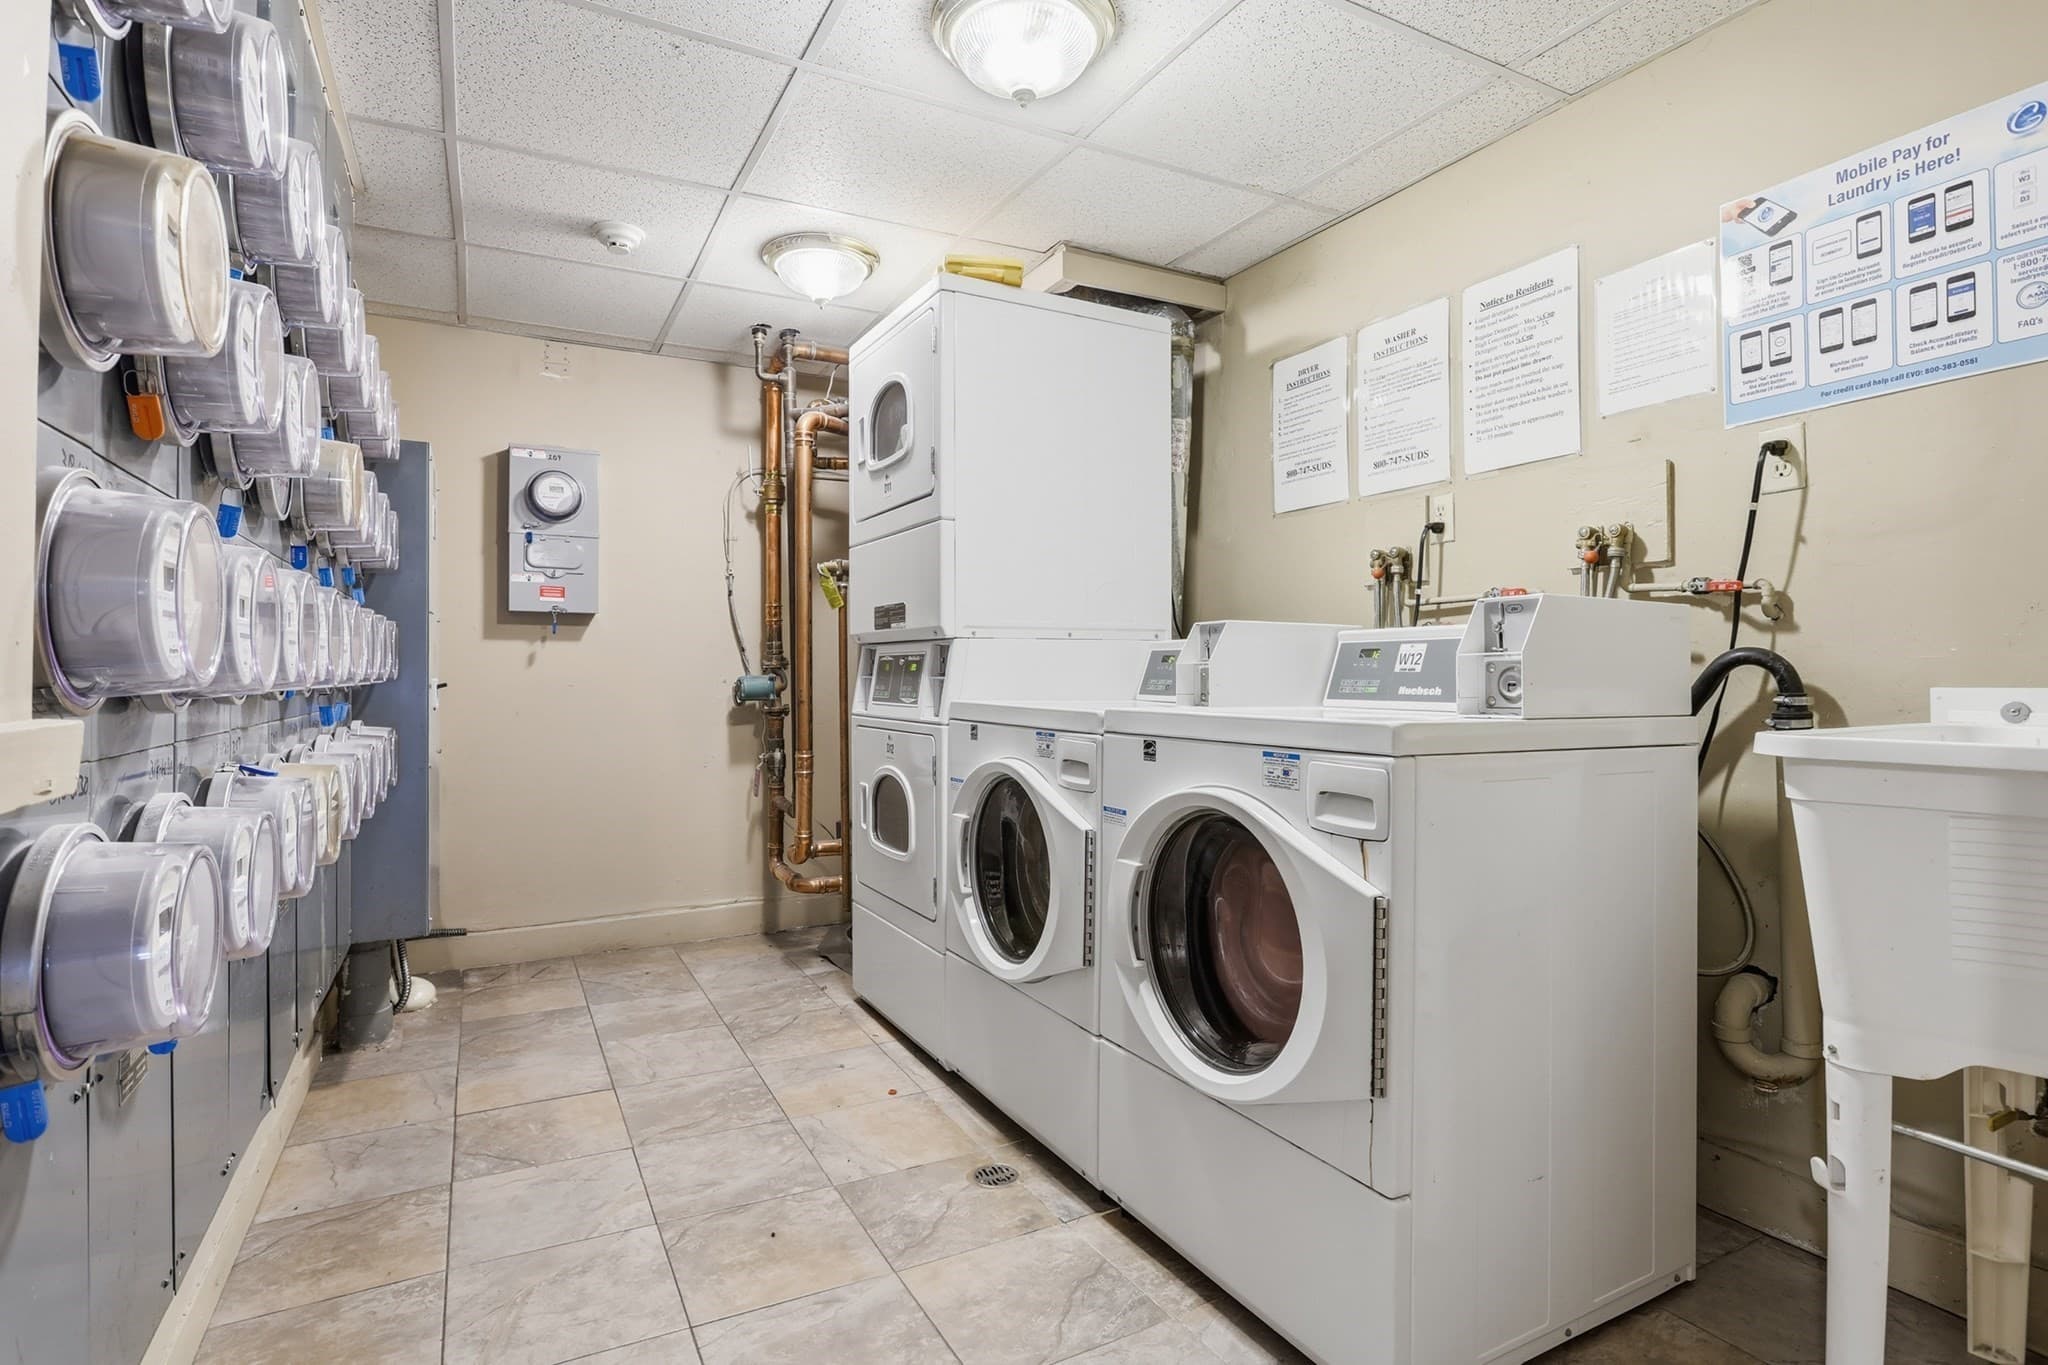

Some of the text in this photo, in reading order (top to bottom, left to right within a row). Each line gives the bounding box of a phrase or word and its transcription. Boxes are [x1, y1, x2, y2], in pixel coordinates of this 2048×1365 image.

[1836, 133, 1950, 184] Mobile Pay for
[1828, 147, 1961, 207] Laundry is Here!
[1480, 278, 1554, 311] Notice to Residents
[2018, 316, 2043, 328] FAQ's
[1384, 327, 1416, 344] WASHER
[1373, 335, 1429, 360] INSTRUCTIONS
[1287, 369, 1330, 391] INSTRUCTIONS
[1298, 363, 1319, 377] DRYER
[1820, 390, 1832, 398] For
[1833, 384, 1854, 396] credit
[1855, 381, 1871, 391] card
[1872, 377, 1889, 387] help
[1890, 372, 1904, 382] call
[1286, 461, 1332, 479] 800-747-SUDS
[1373, 449, 1430, 470] 800-747-SUDS
[1399, 652, 1423, 666] W12
[1398, 685, 1442, 697] Huebsch
